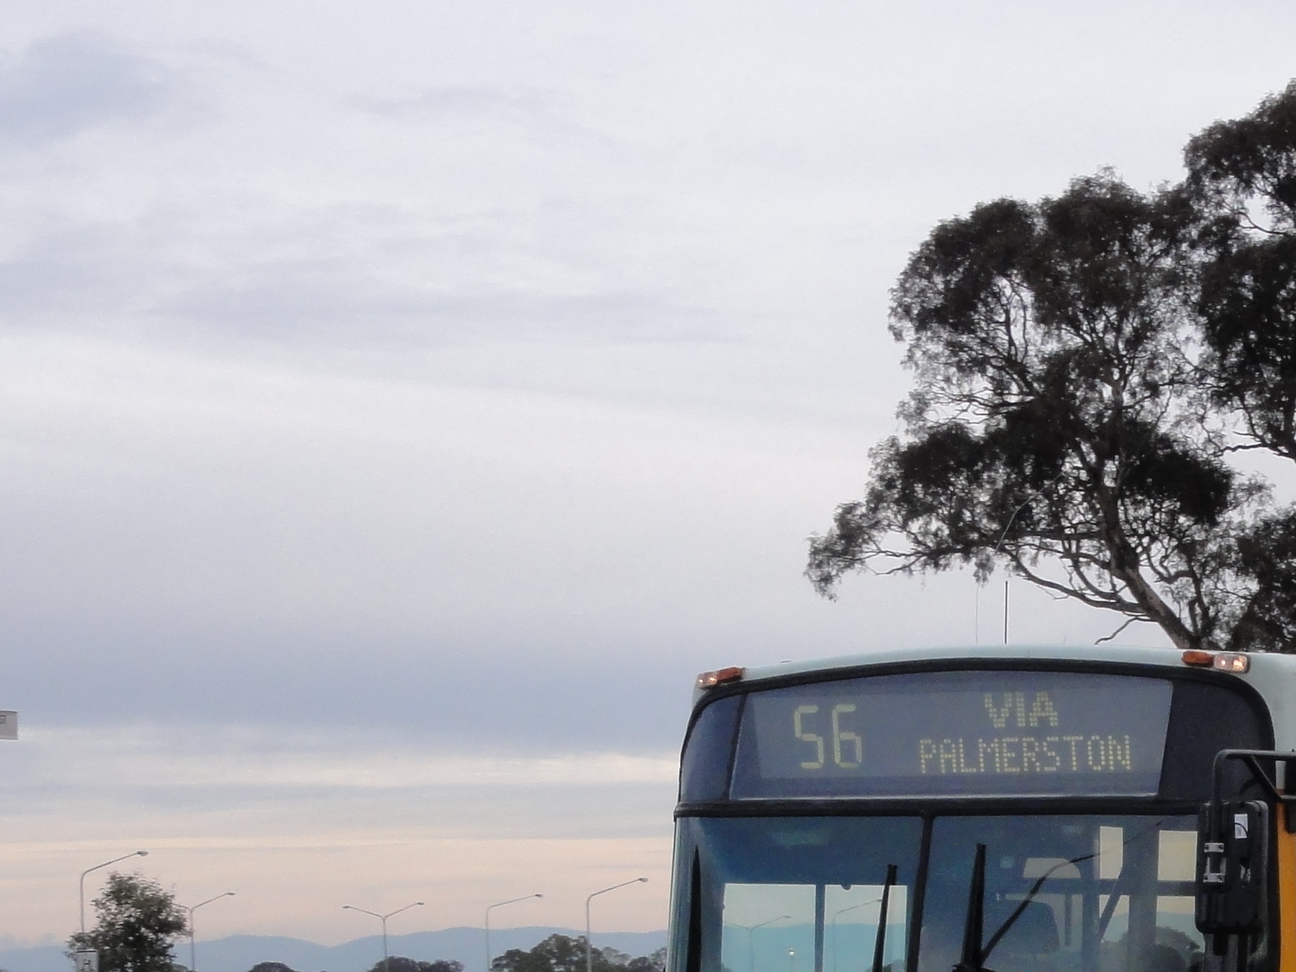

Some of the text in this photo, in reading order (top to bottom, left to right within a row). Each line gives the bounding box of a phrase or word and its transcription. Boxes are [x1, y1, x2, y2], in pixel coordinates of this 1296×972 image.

[983, 691, 1059, 729] VIA
[793, 703, 863, 770] 56
[918, 734, 1131, 774] PALMERSTON
